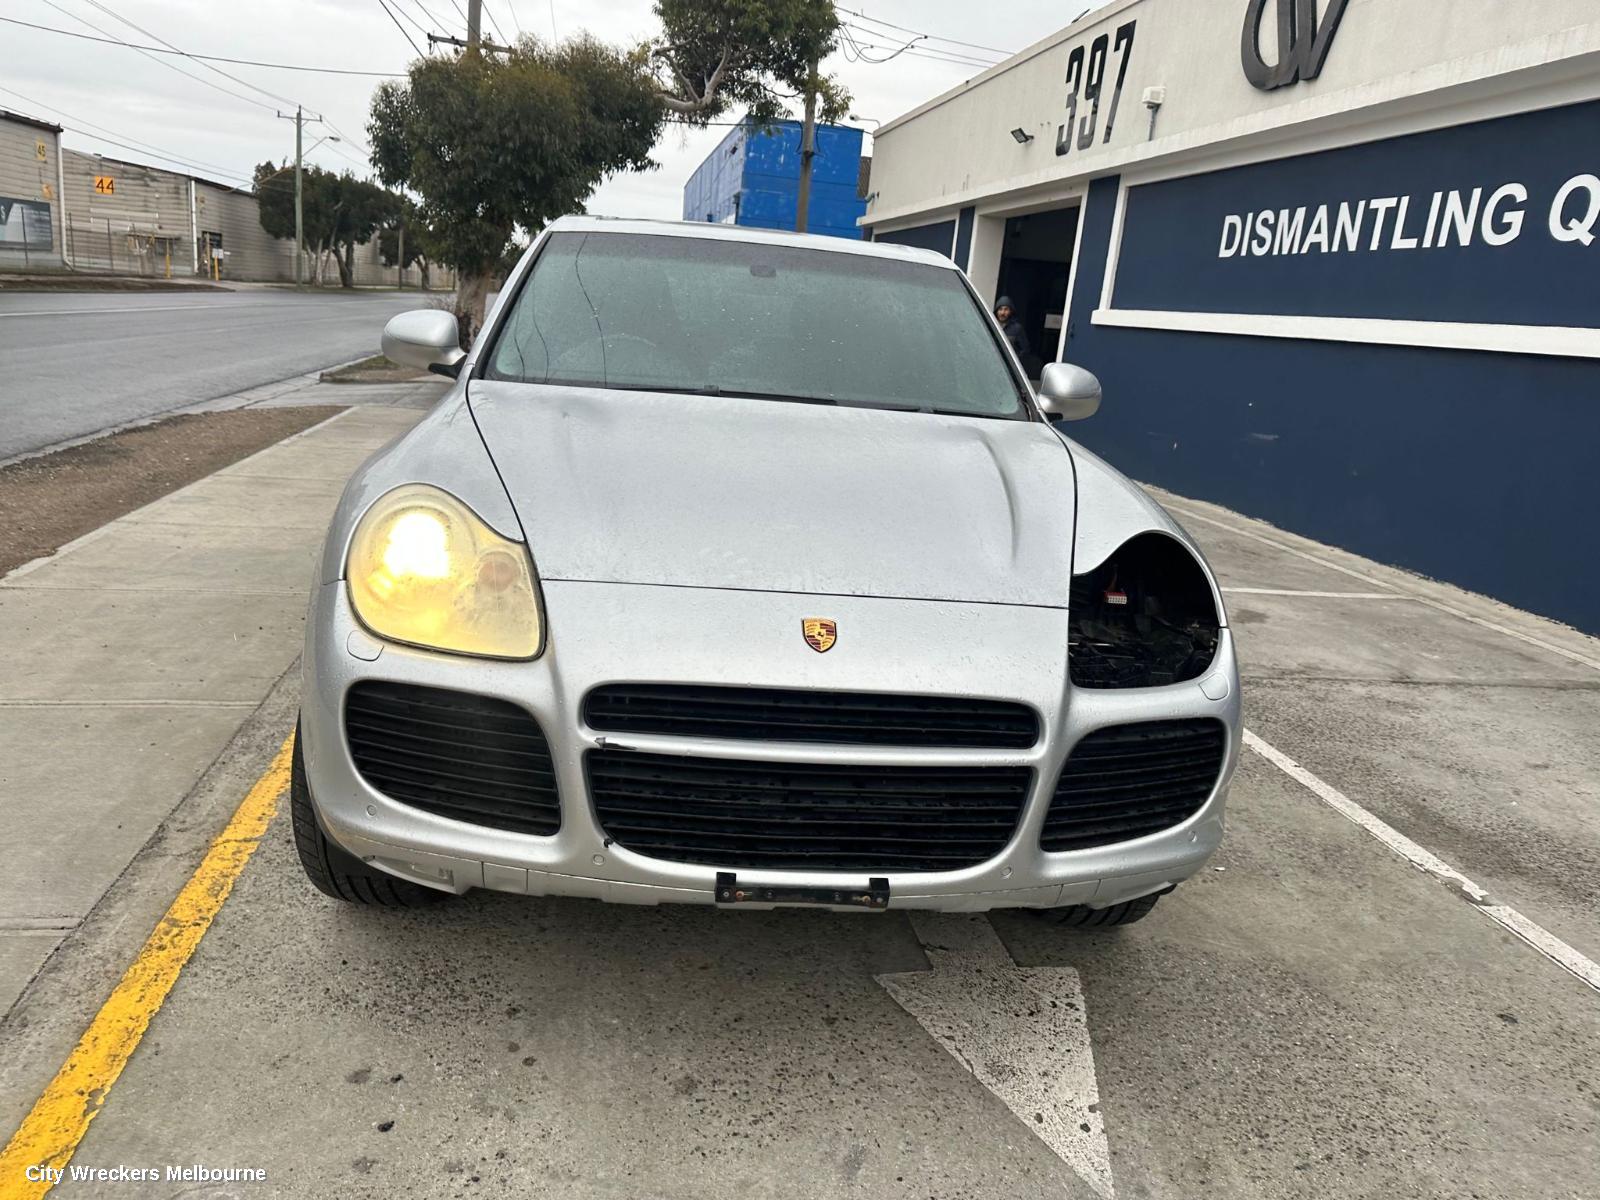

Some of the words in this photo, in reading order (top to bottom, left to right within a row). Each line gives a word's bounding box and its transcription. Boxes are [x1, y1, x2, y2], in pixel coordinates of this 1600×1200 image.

[1055, 19, 1137, 157] 397
[95, 177, 114, 194] 44
[1218, 182, 1528, 258] DISMANTLING
[1548, 173, 1600, 247] Q
